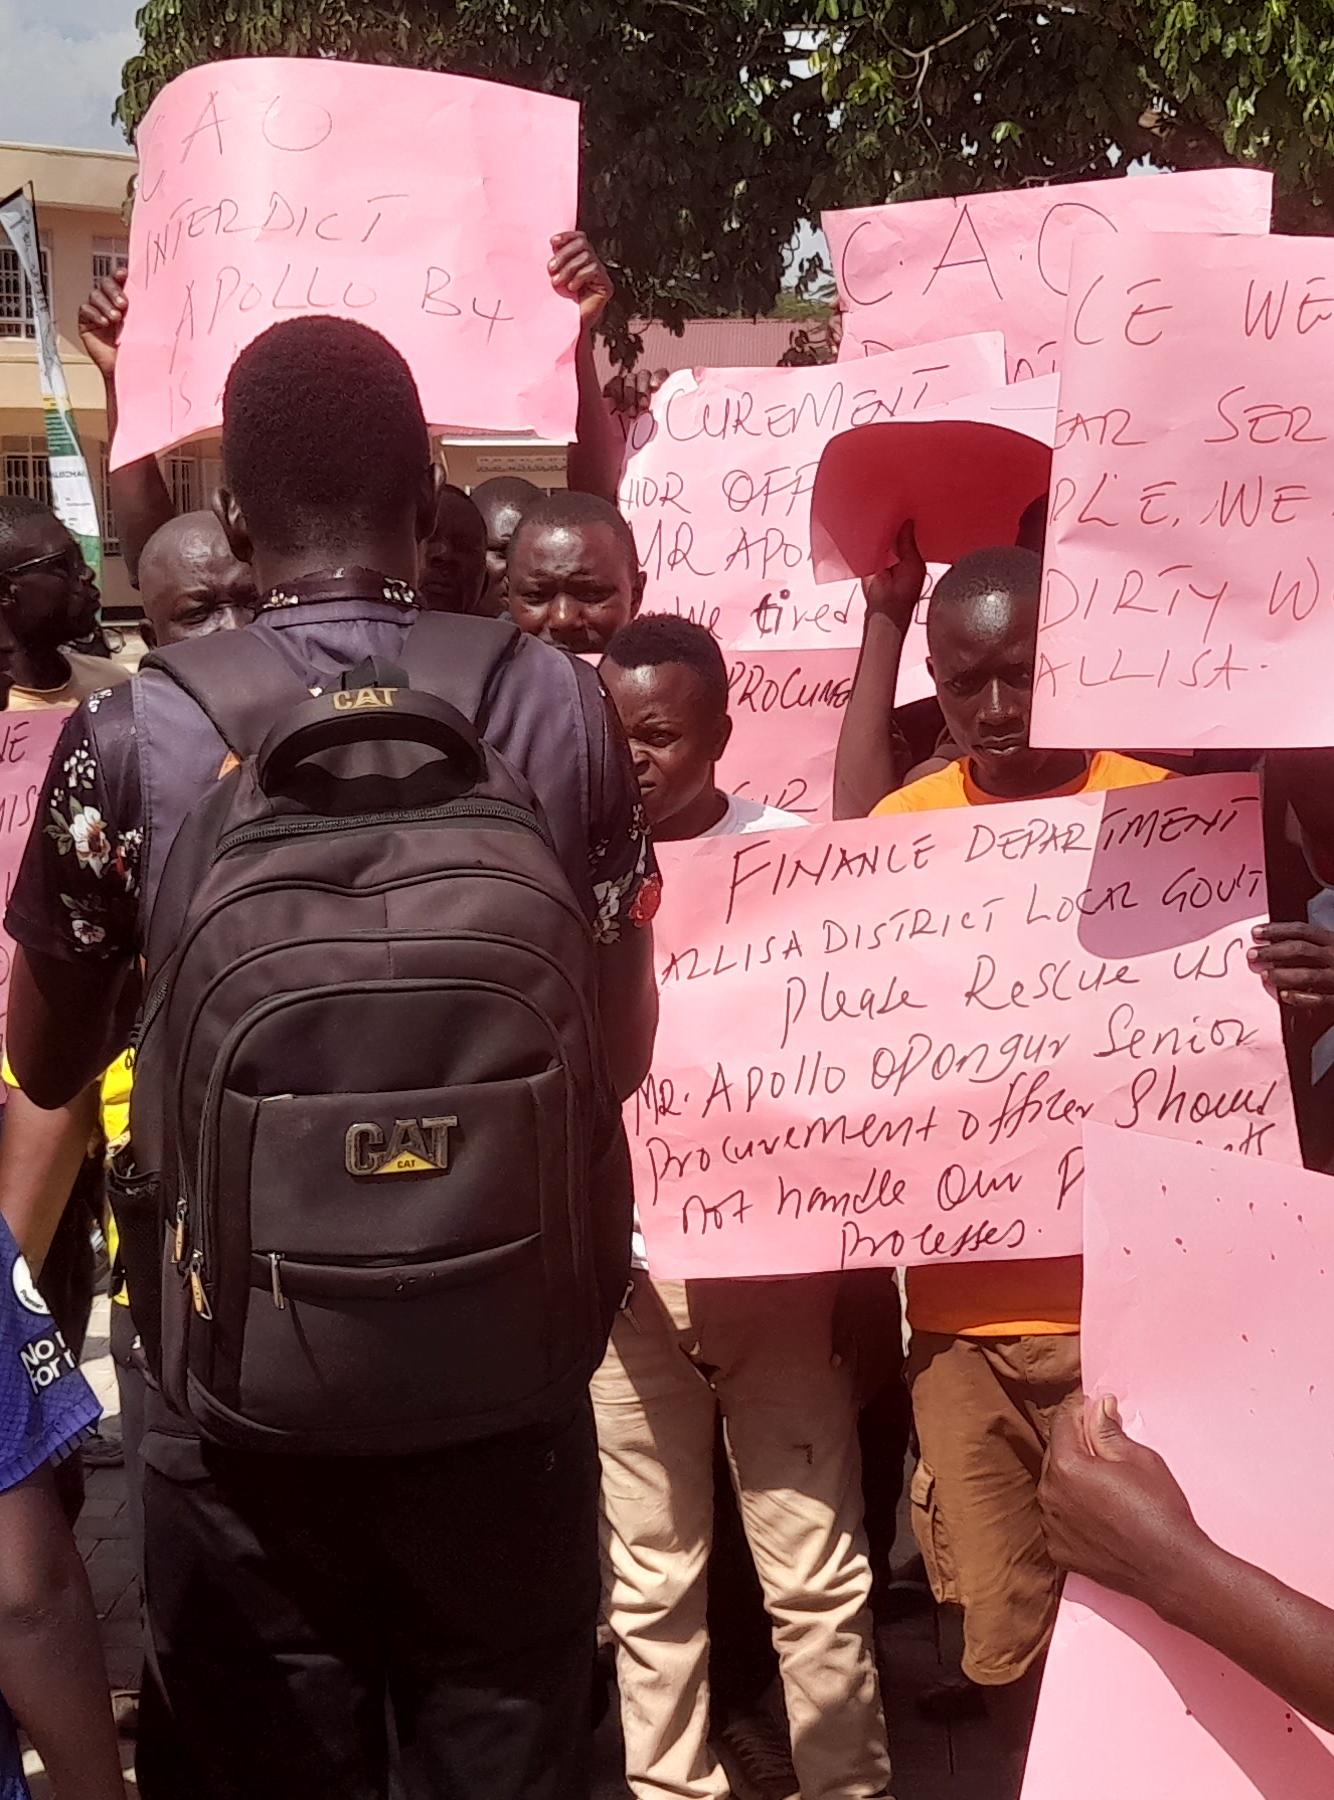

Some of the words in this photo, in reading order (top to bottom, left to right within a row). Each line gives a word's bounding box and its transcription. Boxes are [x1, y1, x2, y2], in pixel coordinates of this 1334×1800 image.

[144, 191, 410, 291] INTERDICT
[168, 263, 378, 376] APOLLO
[1200, 475, 1312, 529] WE
[723, 525, 814, 580] APO
[1038, 564, 1229, 644] DIRTY
[332, 686, 399, 712] CAT
[725, 832, 937, 926] FINANCE
[964, 796, 1261, 863] DEPARTMENT
[822, 896, 1006, 955] DISTRICT
[345, 1114, 458, 1176] CAT
